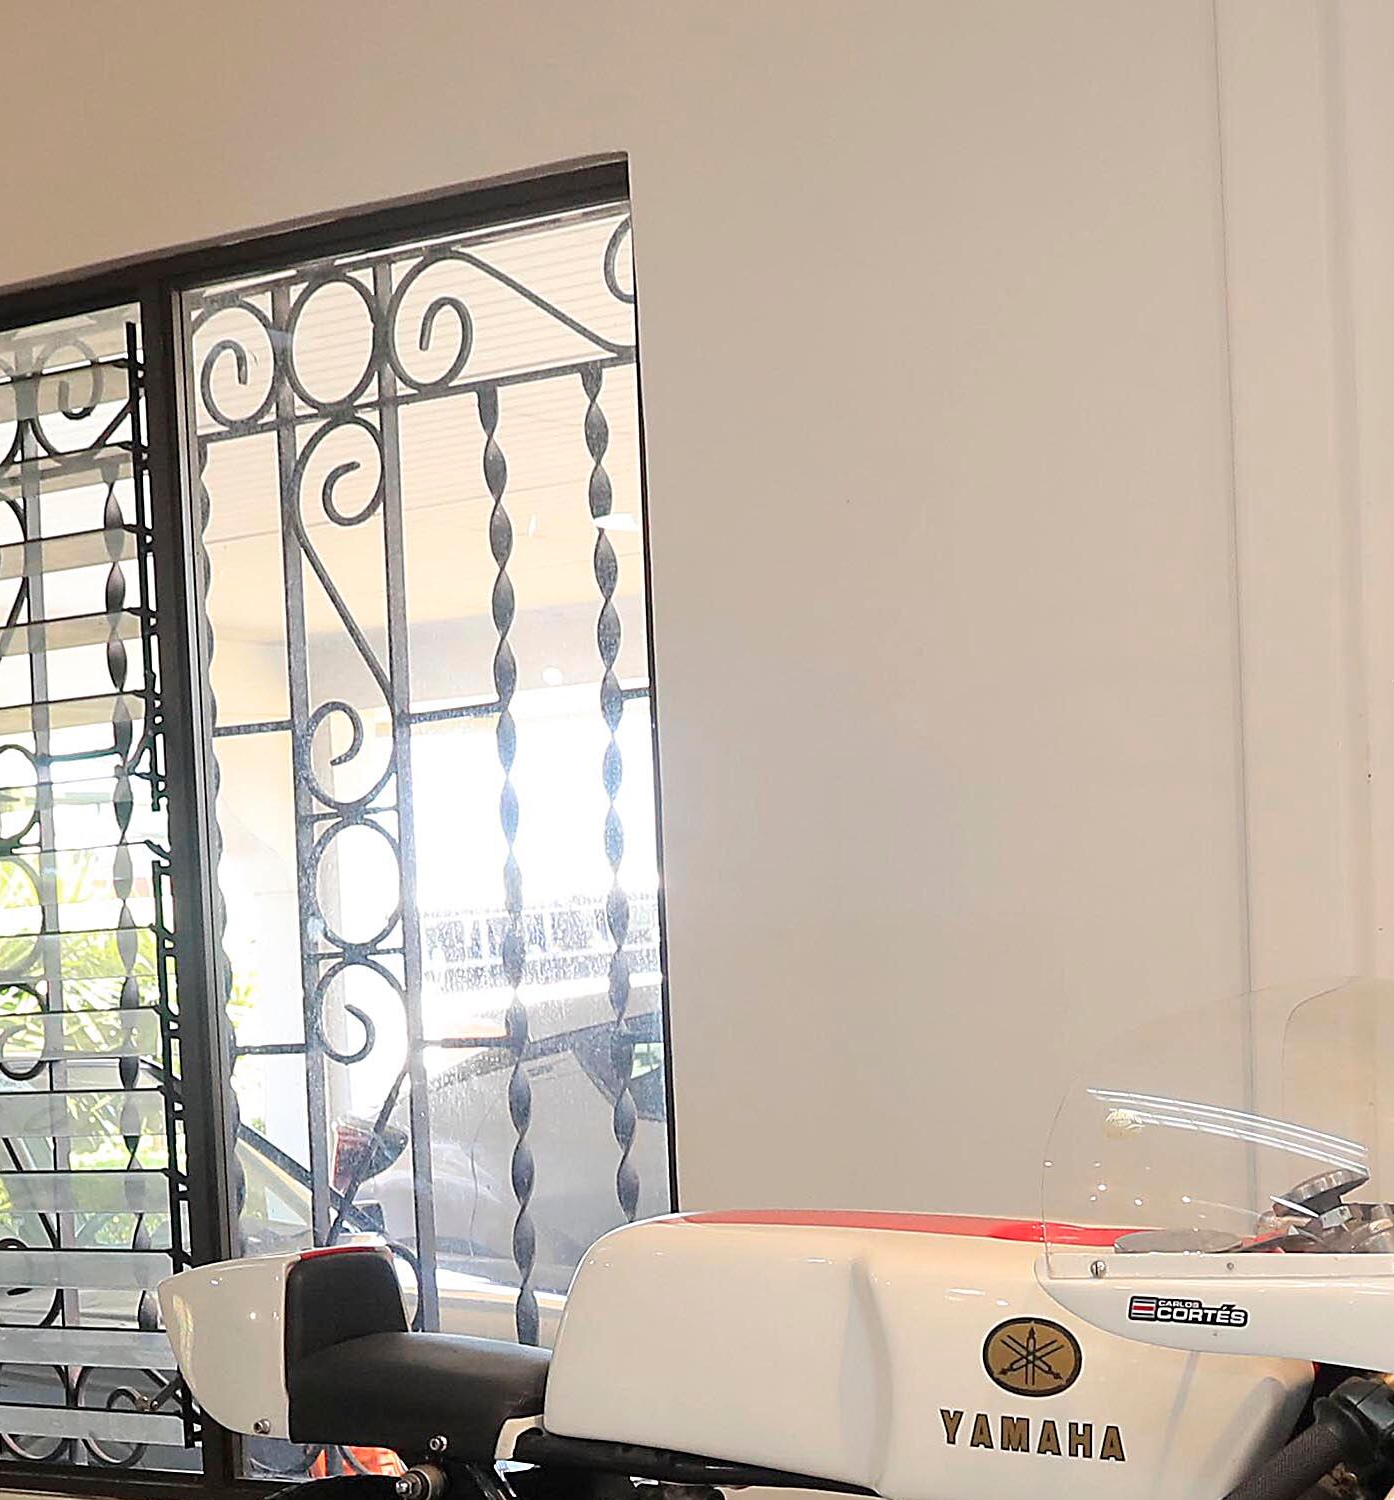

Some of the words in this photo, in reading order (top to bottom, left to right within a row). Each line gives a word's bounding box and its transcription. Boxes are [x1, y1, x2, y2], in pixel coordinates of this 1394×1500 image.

[1158, 1299, 1200, 1309] CARLOS
[1156, 1306, 1246, 1325] CORTÉS
[939, 1408, 1126, 1462] YAMAHA
